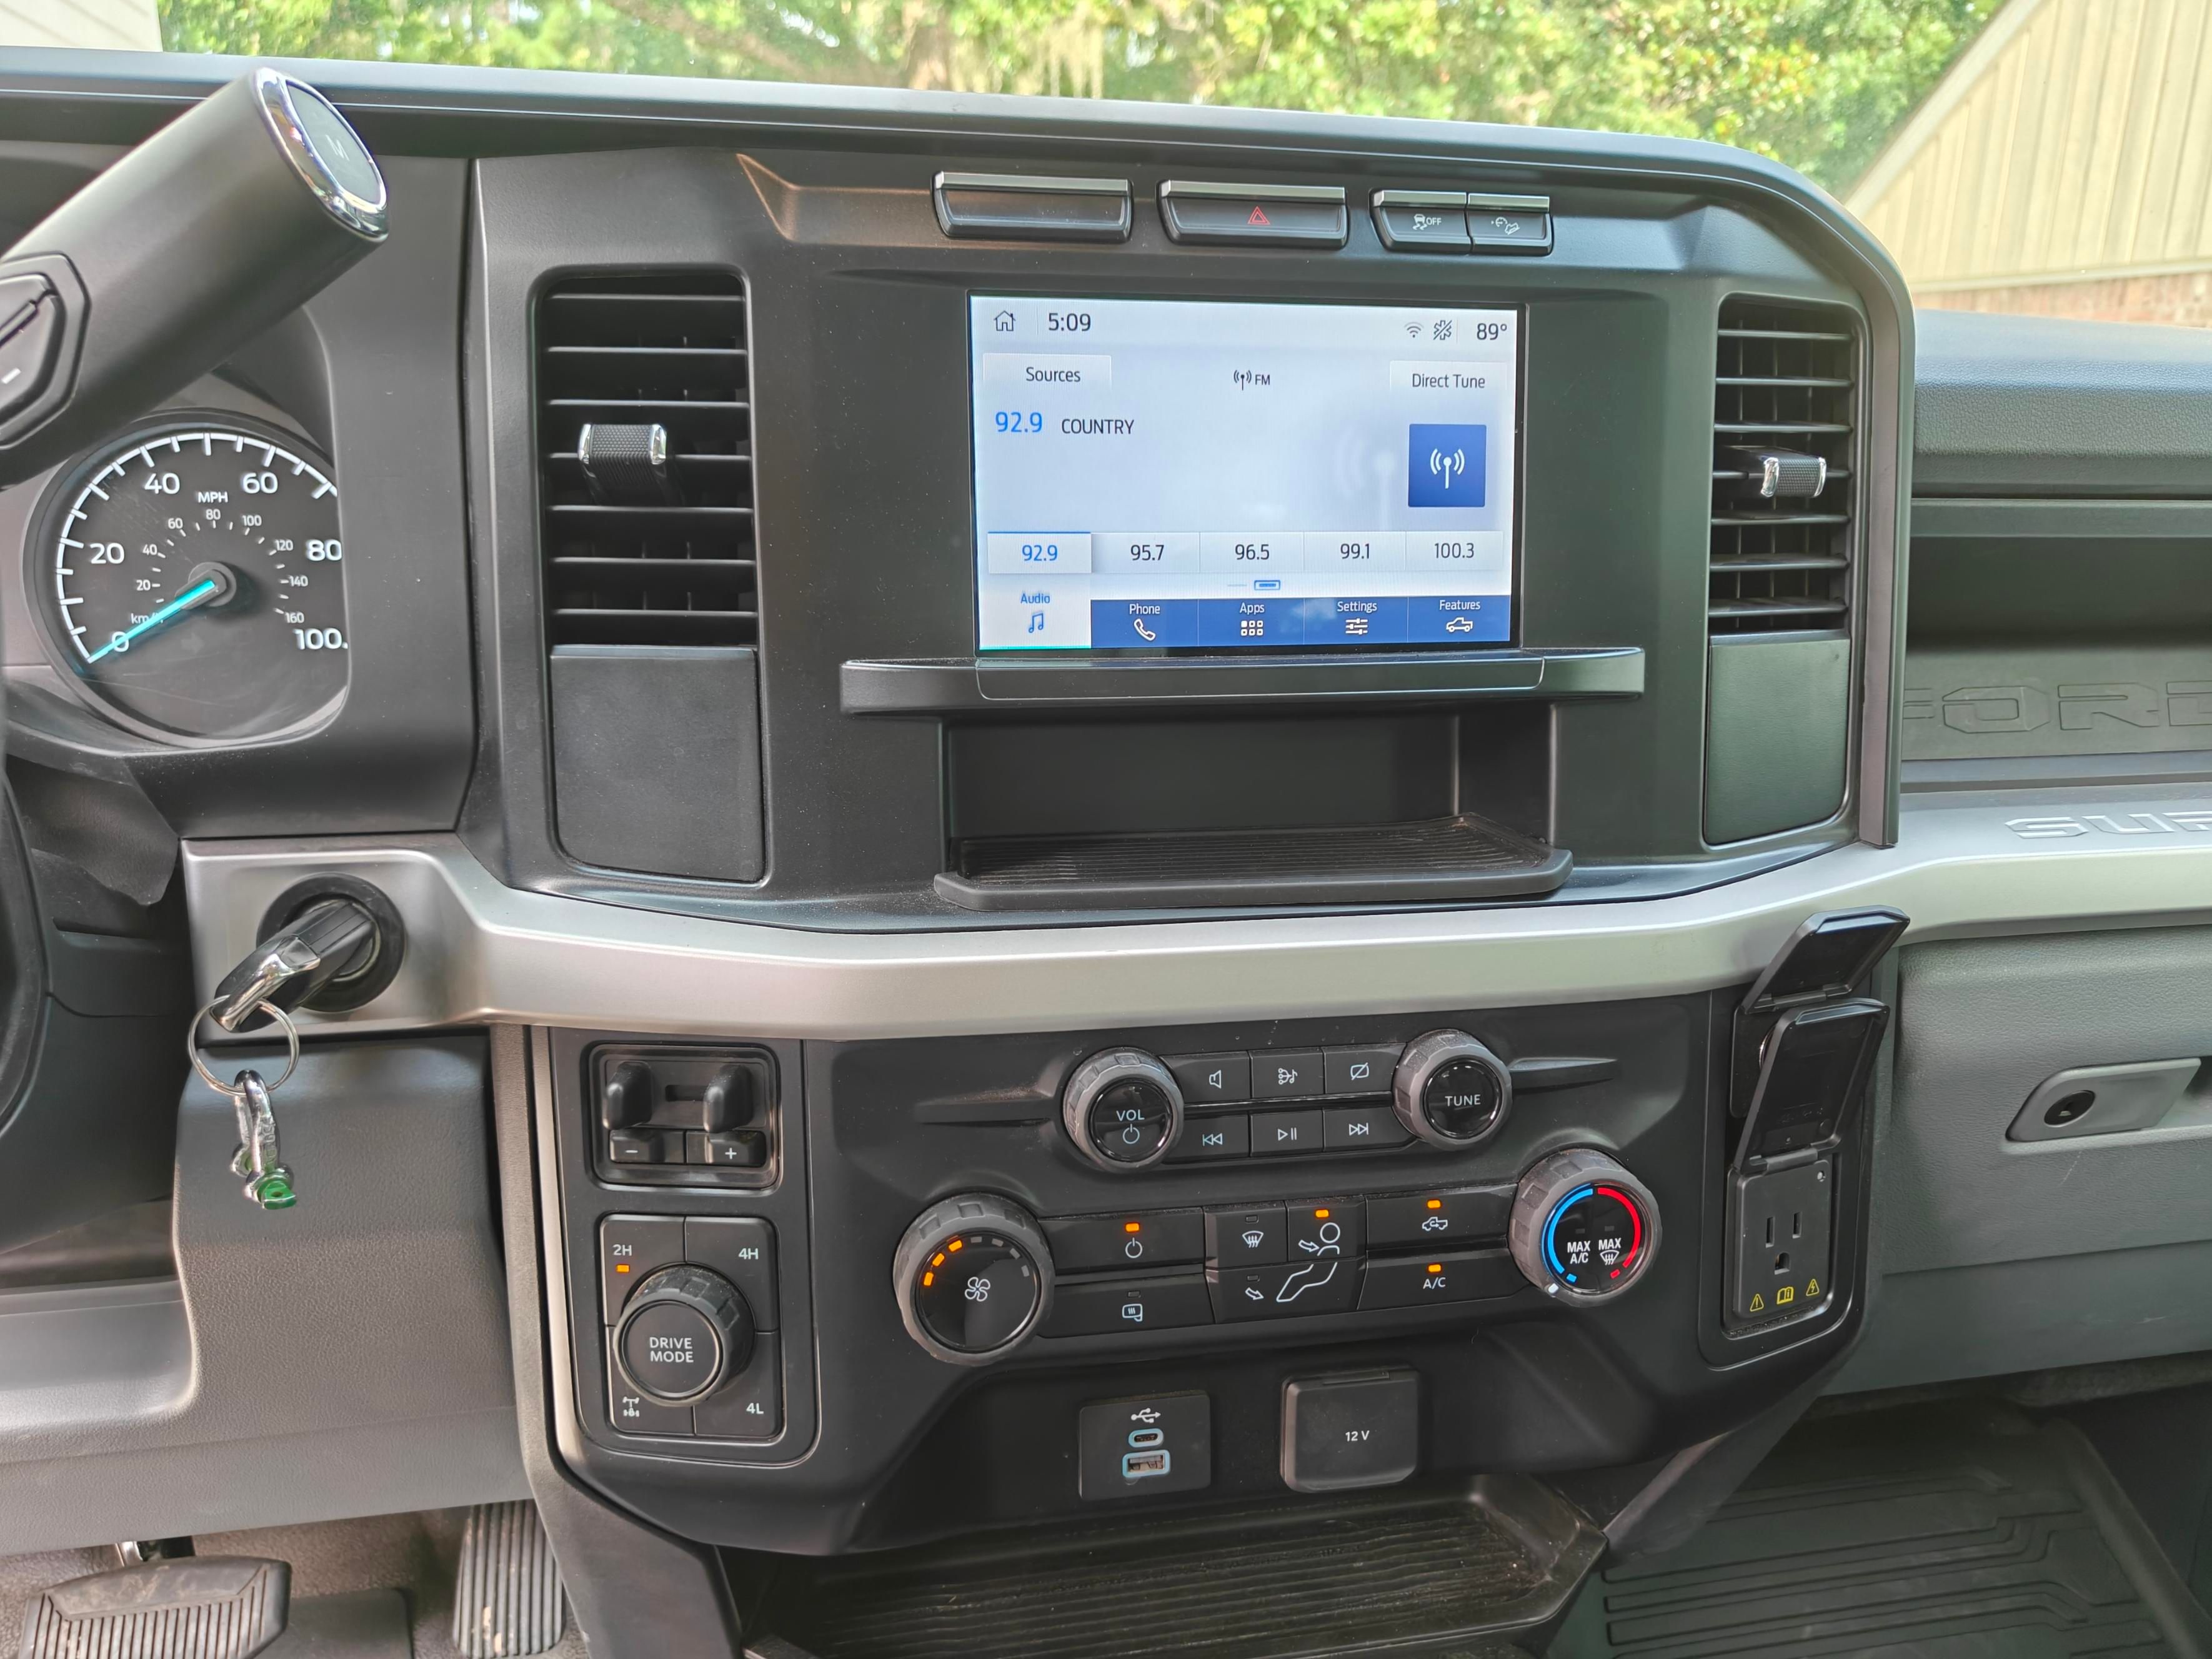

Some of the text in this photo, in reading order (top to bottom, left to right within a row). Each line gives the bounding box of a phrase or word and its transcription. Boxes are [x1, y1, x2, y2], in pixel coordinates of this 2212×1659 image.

[1426, 217, 1442, 226] OFF
[1049, 313, 1091, 331] 5:09
[1026, 367, 1081, 382] Sources
[1255, 375, 1270, 386] FM
[1412, 373, 1485, 388] Direct Tune
[995, 412, 1135, 435] 92.9 COUNTRY
[144, 472, 180, 494] 40
[242, 472, 278, 494] 60
[197, 491, 228, 503] MPH
[206, 509, 221, 521] 80
[242, 515, 262, 527] 100
[167, 517, 183, 529] 60
[142, 544, 157, 555] 40
[275, 539, 294, 551] 120
[306, 539, 342, 561] 80
[1340, 543, 1370, 559] 99.1
[1434, 542, 1475, 559] 100.3
[90, 542, 124, 564] 20
[1022, 545, 1058, 561] 92.9
[1130, 544, 1165, 560] 95.7
[1235, 544, 1270, 560] 96.5
[136, 579, 151, 590] 20
[289, 575, 309, 587] 140
[1020, 593, 1050, 604] Audio
[1129, 604, 1160, 615] Phone
[1239, 603, 1265, 614] Apps
[1337, 601, 1377, 612] Settings
[1439, 600, 1481, 610] Features
[284, 612, 304, 624] 160
[1445, 1094, 1481, 1107] TUNE
[1116, 1110, 1145, 1121] VOL
[613, 1244, 632, 1255] 2H
[1567, 1240, 1591, 1253] MAX
[1598, 1238, 1621, 1250] MAX
[739, 1247, 759, 1260] 4H
[1570, 1252, 1588, 1263] A/C
[1423, 1277, 1446, 1289] A/C
[649, 1337, 692, 1349] DRIVE
[650, 1350, 694, 1363] MODE
[746, 1403, 764, 1414] 4L
[1345, 1430, 1370, 1442] 12 V
